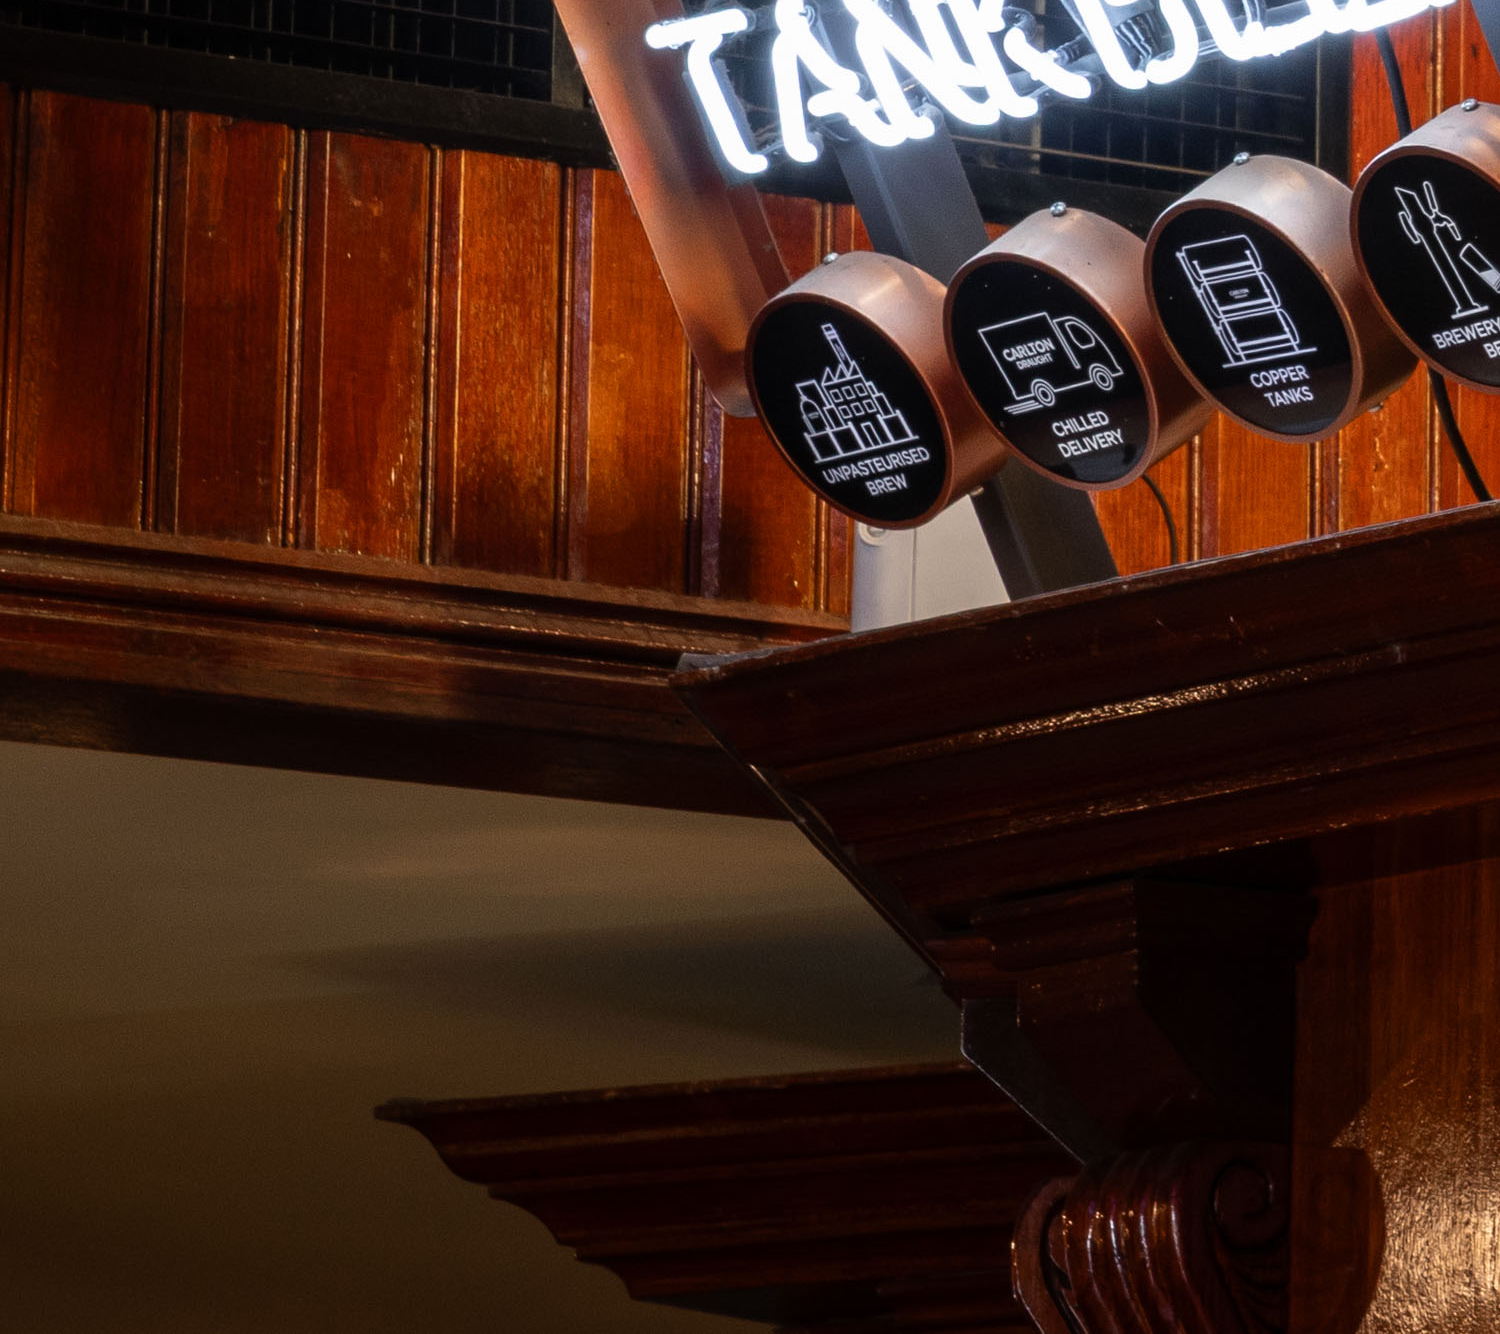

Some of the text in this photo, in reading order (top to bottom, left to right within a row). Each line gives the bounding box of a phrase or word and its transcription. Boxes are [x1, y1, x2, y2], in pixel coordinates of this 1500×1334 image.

[1002, 338, 1057, 363] CARLTON
[1017, 351, 1054, 371] DRAUGHT
[1249, 364, 1310, 390] COPPER
[1264, 385, 1315, 410] TANKS
[1051, 410, 1110, 438] CHILLED
[1057, 425, 1126, 459] DELIVERY
[822, 445, 931, 485] UNPASTEURISED
[865, 474, 909, 497] BREW
